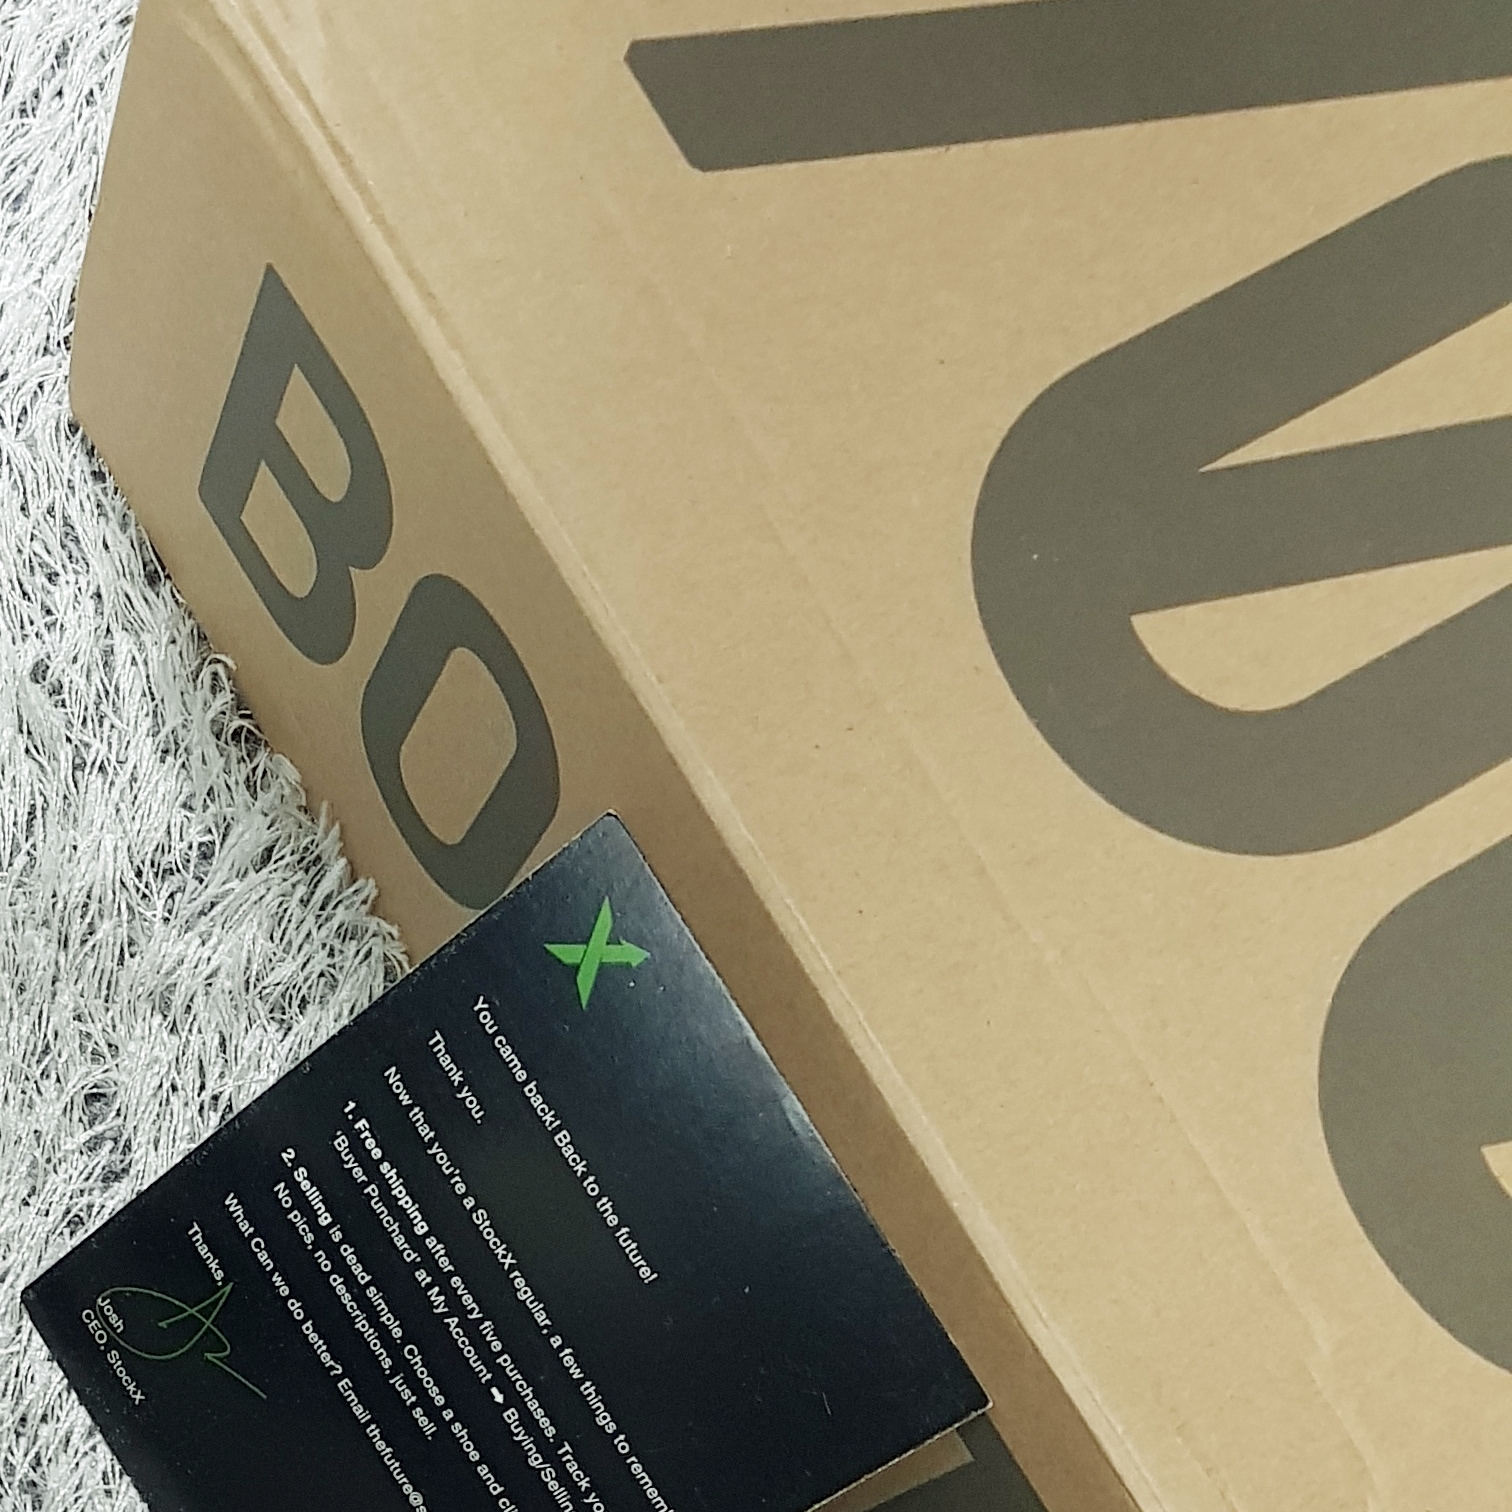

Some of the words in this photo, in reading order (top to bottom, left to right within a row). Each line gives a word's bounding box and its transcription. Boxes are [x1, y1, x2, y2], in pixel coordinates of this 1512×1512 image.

[428, 1029, 464, 1087] Thank
[455, 1085, 485, 1125] you.
[473, 995, 499, 1035] You
[494, 1035, 528, 1083] came
[523, 1080, 562, 1131] back!
[553, 1129, 588, 1178] Back
[582, 1175, 600, 1197] to
[596, 1196, 619, 1227] the
[614, 1226, 659, 1284] future!
[81, 1309, 108, 1351] CEO,
[106, 1349, 146, 1406] StockX
[97, 1297, 125, 1333] Josh
[187, 1221, 225, 1287] Thanks,
[224, 1192, 255, 1238] What
[250, 1237, 274, 1272] Can
[271, 1271, 290, 1297] we
[286, 1298, 305, 1321] do
[301, 1319, 343, 1377] better?
[336, 1377, 372, 1424] Email
[273, 1181, 293, 1209] No
[286, 1209, 315, 1250] pics,
[313, 1249, 332, 1272] no
[329, 1273, 393, 1375] descriptions,
[388, 1372, 418, 1407] just
[411, 1406, 438, 1441] sell.
[280, 1147, 296, 1168] 2.
[293, 1166, 333, 1227] Selling
[328, 1223, 343, 1243] is
[339, 1243, 373, 1286] dead
[365, 1285, 403, 1344] simple.
[403, 1344, 446, 1407] Choose
[441, 1408, 455, 1422] a
[450, 1421, 481, 1462] shoe
[476, 1463, 505, 1496] and
[328, 1130, 369, 1184] 'Buyer
[363, 1181, 422, 1263] Punchard'
[414, 1268, 433, 1288] at
[426, 1285, 450, 1314] My
[443, 1316, 493, 1384] Account
[343, 1100, 357, 1120] 1.
[353, 1117, 383, 1160] Free
[378, 1161, 430, 1236] shipping
[424, 1235, 455, 1273] after
[450, 1275, 484, 1320] every
[478, 1320, 503, 1353] five
[495, 1353, 557, 1443] purchases.
[556, 1440, 591, 1493] Track
[383, 1065, 413, 1106] Now
[408, 1106, 436, 1143] that
[426, 1141, 467, 1195] you're
[462, 1196, 476, 1211] a
[471, 1208, 518, 1271] StockX
[508, 1270, 552, 1335] regular,
[549, 1334, 563, 1350] a
[558, 1347, 585, 1379] few
[579, 1380, 617, 1434] things
[613, 1433, 630, 1454] to
